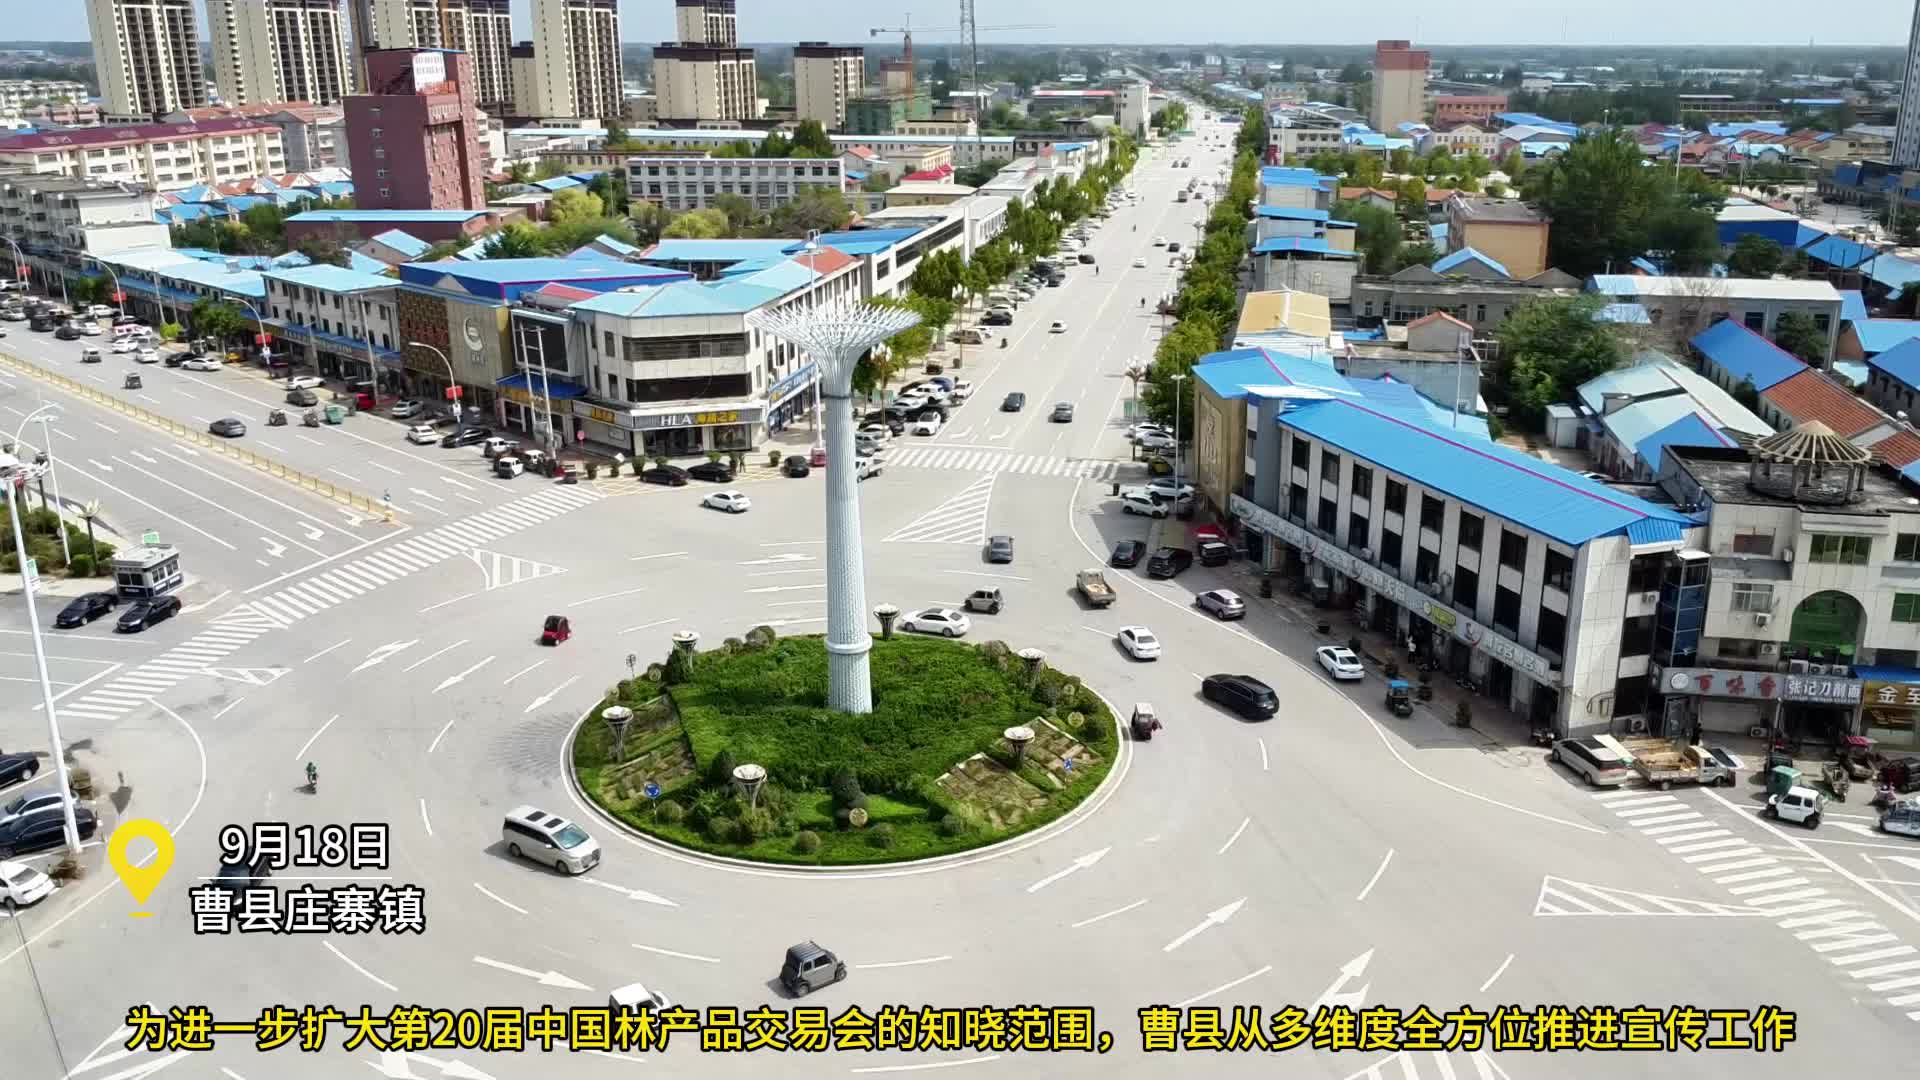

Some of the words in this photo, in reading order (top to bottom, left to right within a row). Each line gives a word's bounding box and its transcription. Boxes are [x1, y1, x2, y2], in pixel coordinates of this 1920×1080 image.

[660, 414, 692, 426] HLA
[1789, 680, 1861, 698] 张记刀削面
